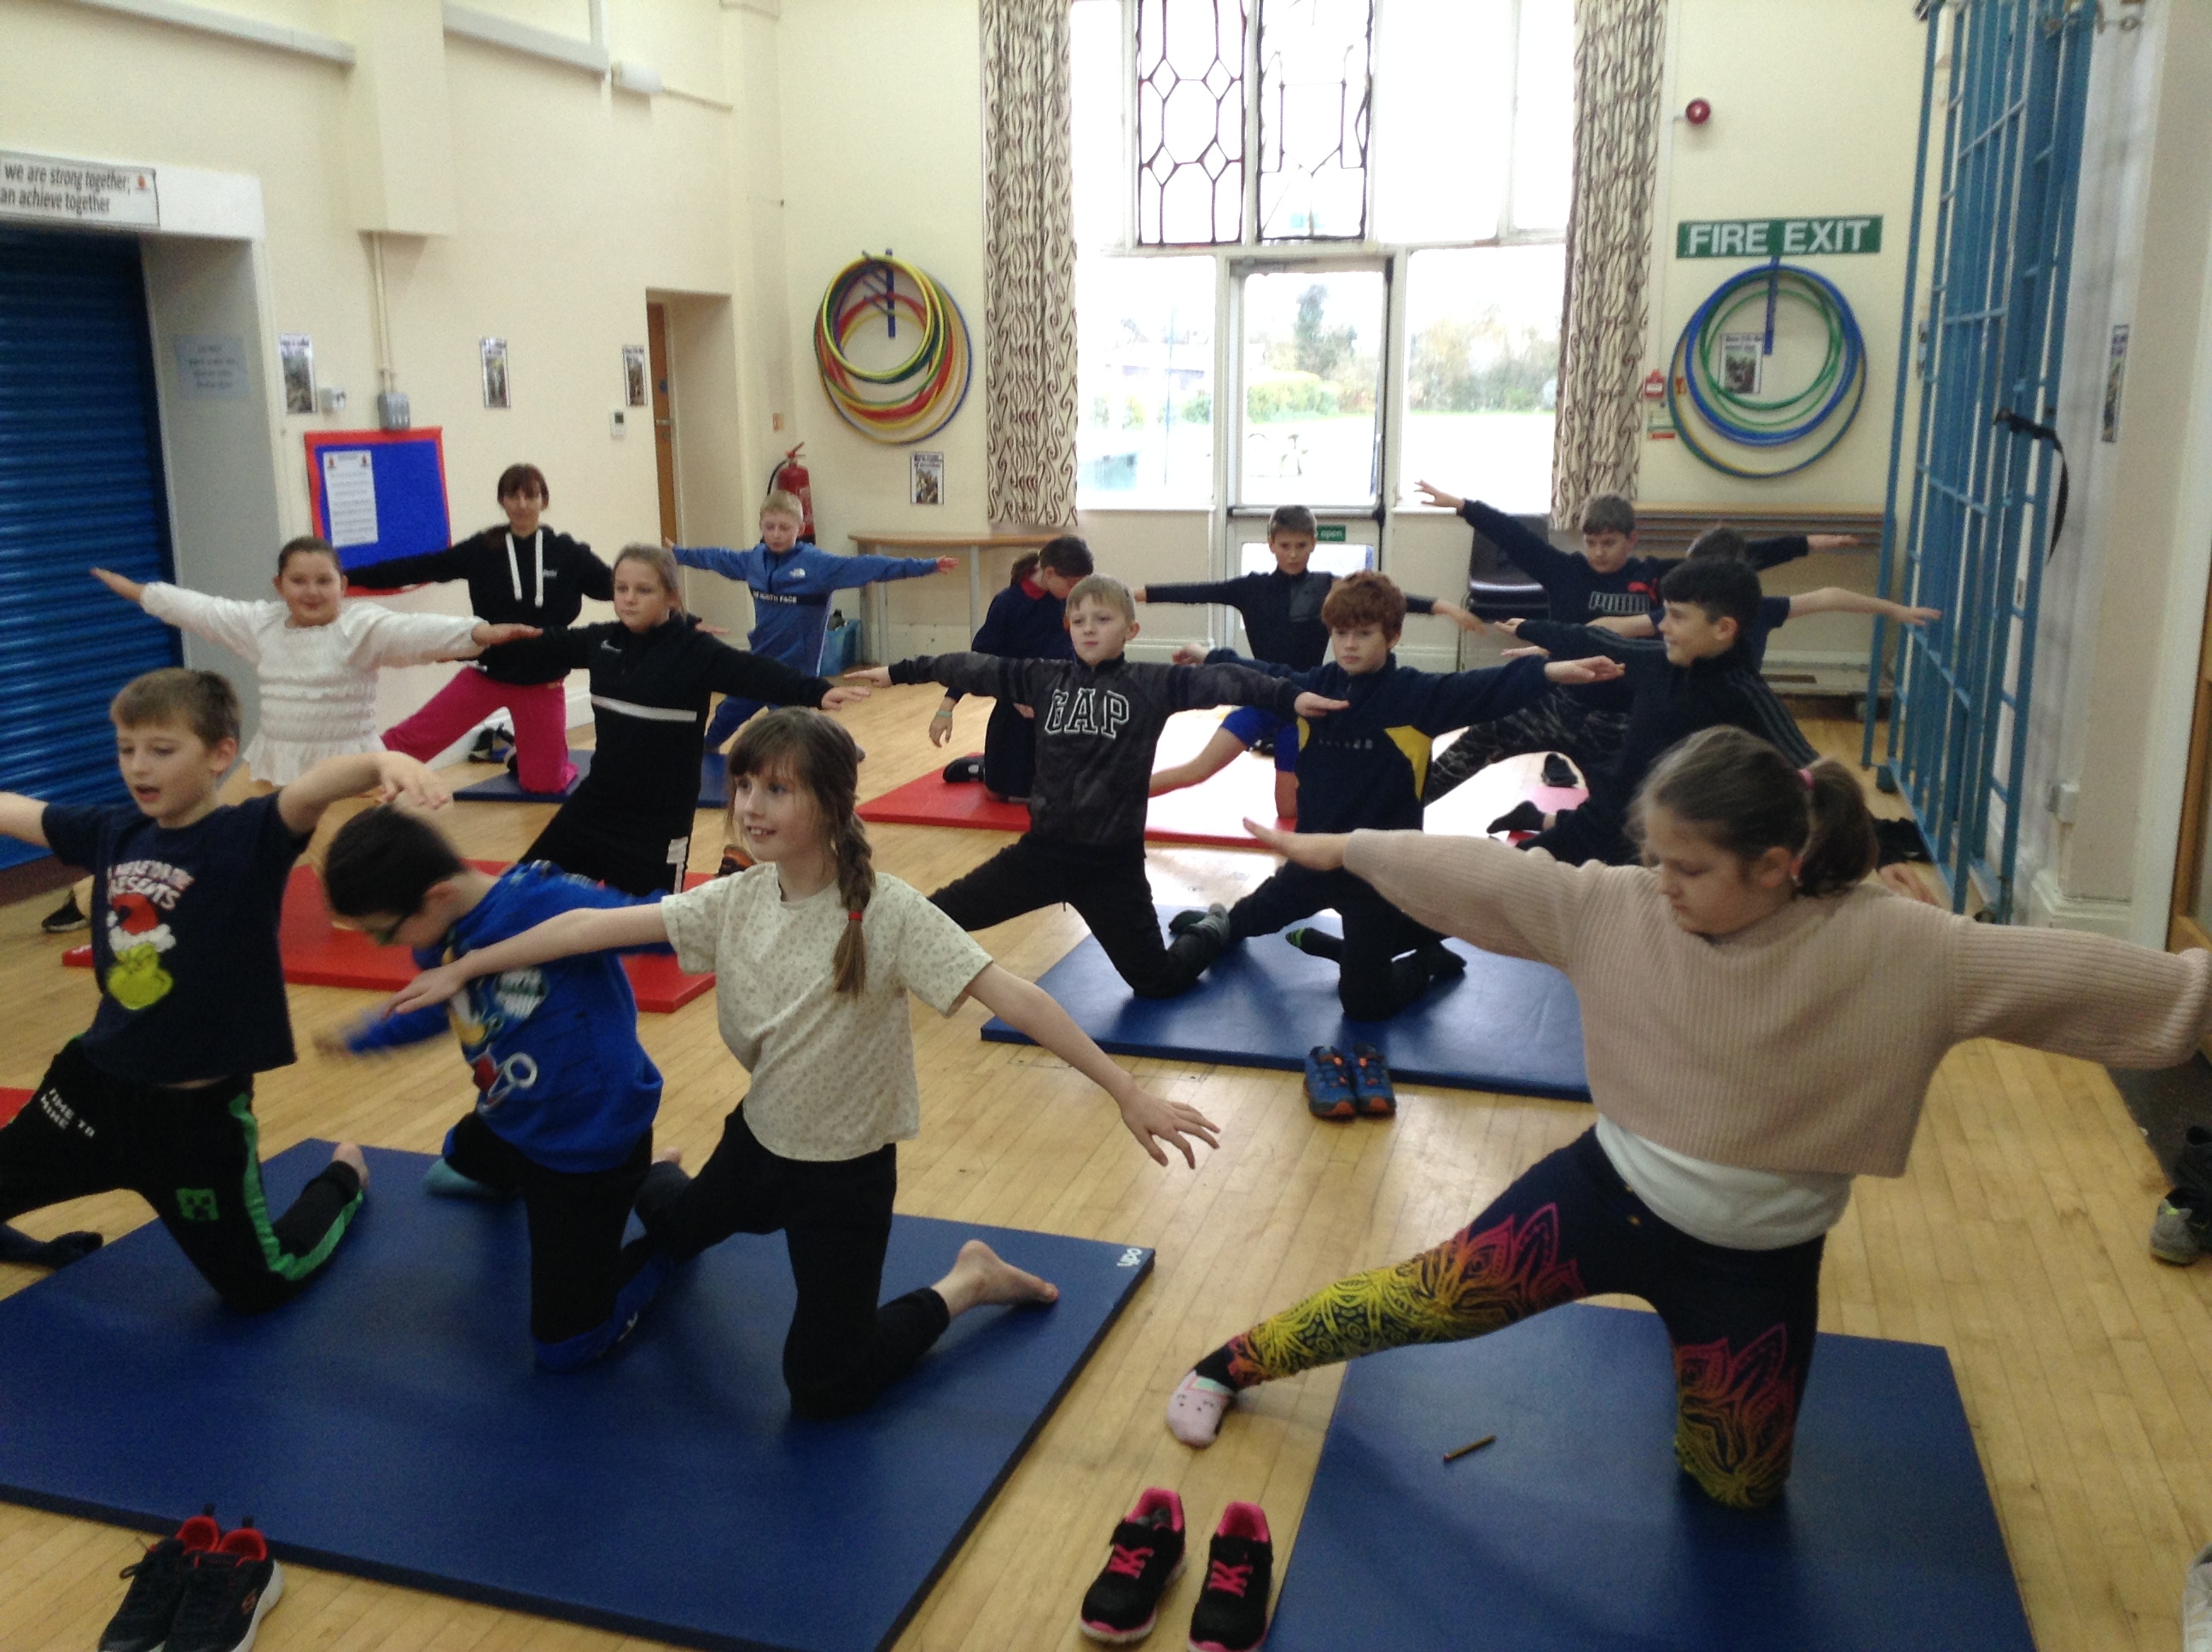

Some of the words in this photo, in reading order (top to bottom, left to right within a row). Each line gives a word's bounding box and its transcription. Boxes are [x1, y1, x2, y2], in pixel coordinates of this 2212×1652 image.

[4, 162, 24, 181] we
[27, 165, 47, 183] are
[50, 167, 83, 190] strong
[20, 184, 62, 208] achieve
[65, 192, 110, 217] together
[1689, 222, 1770, 255] FIRE
[1784, 219, 1871, 253] EXIT
[1044, 687, 1130, 741] GAP
[40, 1094, 68, 1131] MINE
[49, 1087, 75, 1120] TIME
